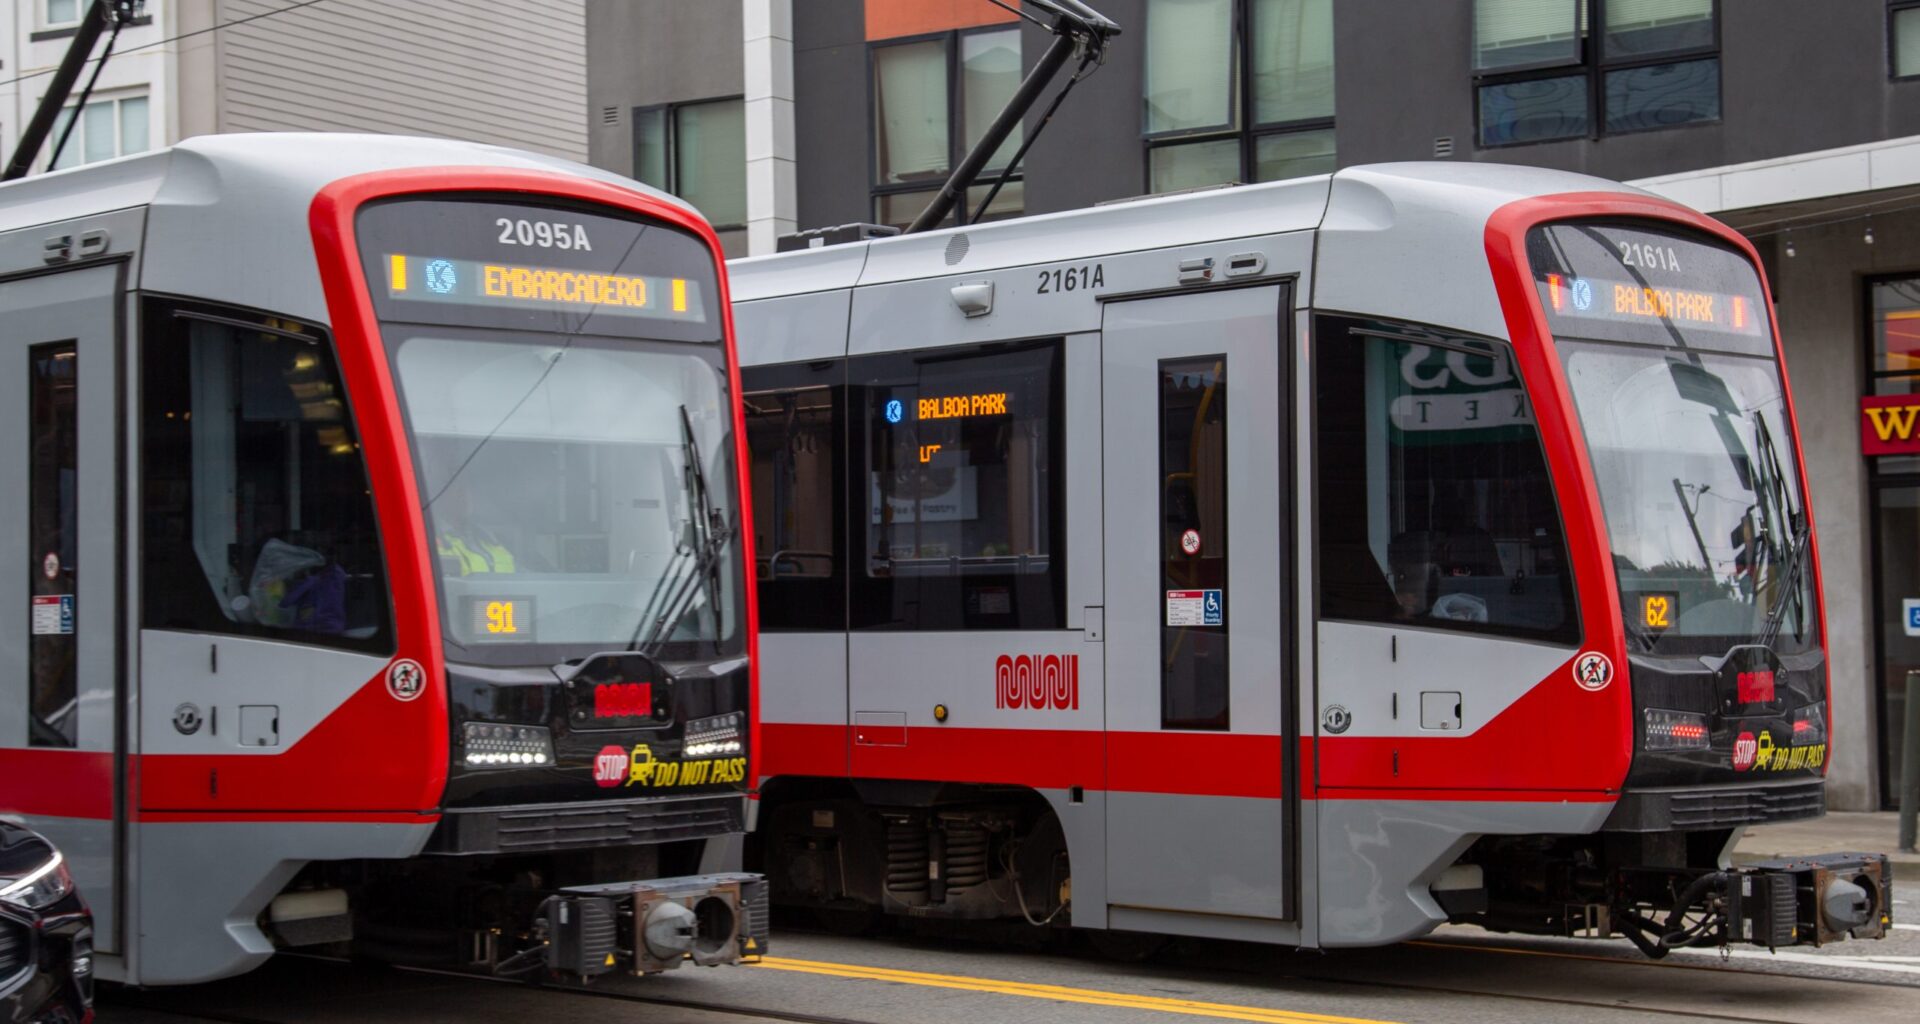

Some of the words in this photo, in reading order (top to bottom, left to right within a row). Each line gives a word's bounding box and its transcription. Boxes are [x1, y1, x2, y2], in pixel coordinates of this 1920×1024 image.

[496, 218, 592, 250] 2095A
[1619, 241, 1681, 272] 2161A
[484, 266, 646, 306] EMBARCADERO
[1037, 264, 1104, 294] 2161A
[1614, 284, 1674, 319] BALBOA
[1676, 291, 1714, 322] PARK
[918, 396, 969, 420] BALBOA
[971, 393, 1006, 415] PARK
[1865, 405, 1920, 441] W
[486, 601, 517, 633] 91
[1647, 596, 1668, 626] 62
[1734, 740, 1756, 764] STOP
[1772, 748, 1789, 771] DO
[1787, 745, 1808, 769] NOT
[1806, 743, 1825, 768] PASS
[596, 755, 628, 781] STOP
[655, 762, 679, 787] DO
[678, 760, 712, 786] NOT
[710, 757, 747, 783] PASS
